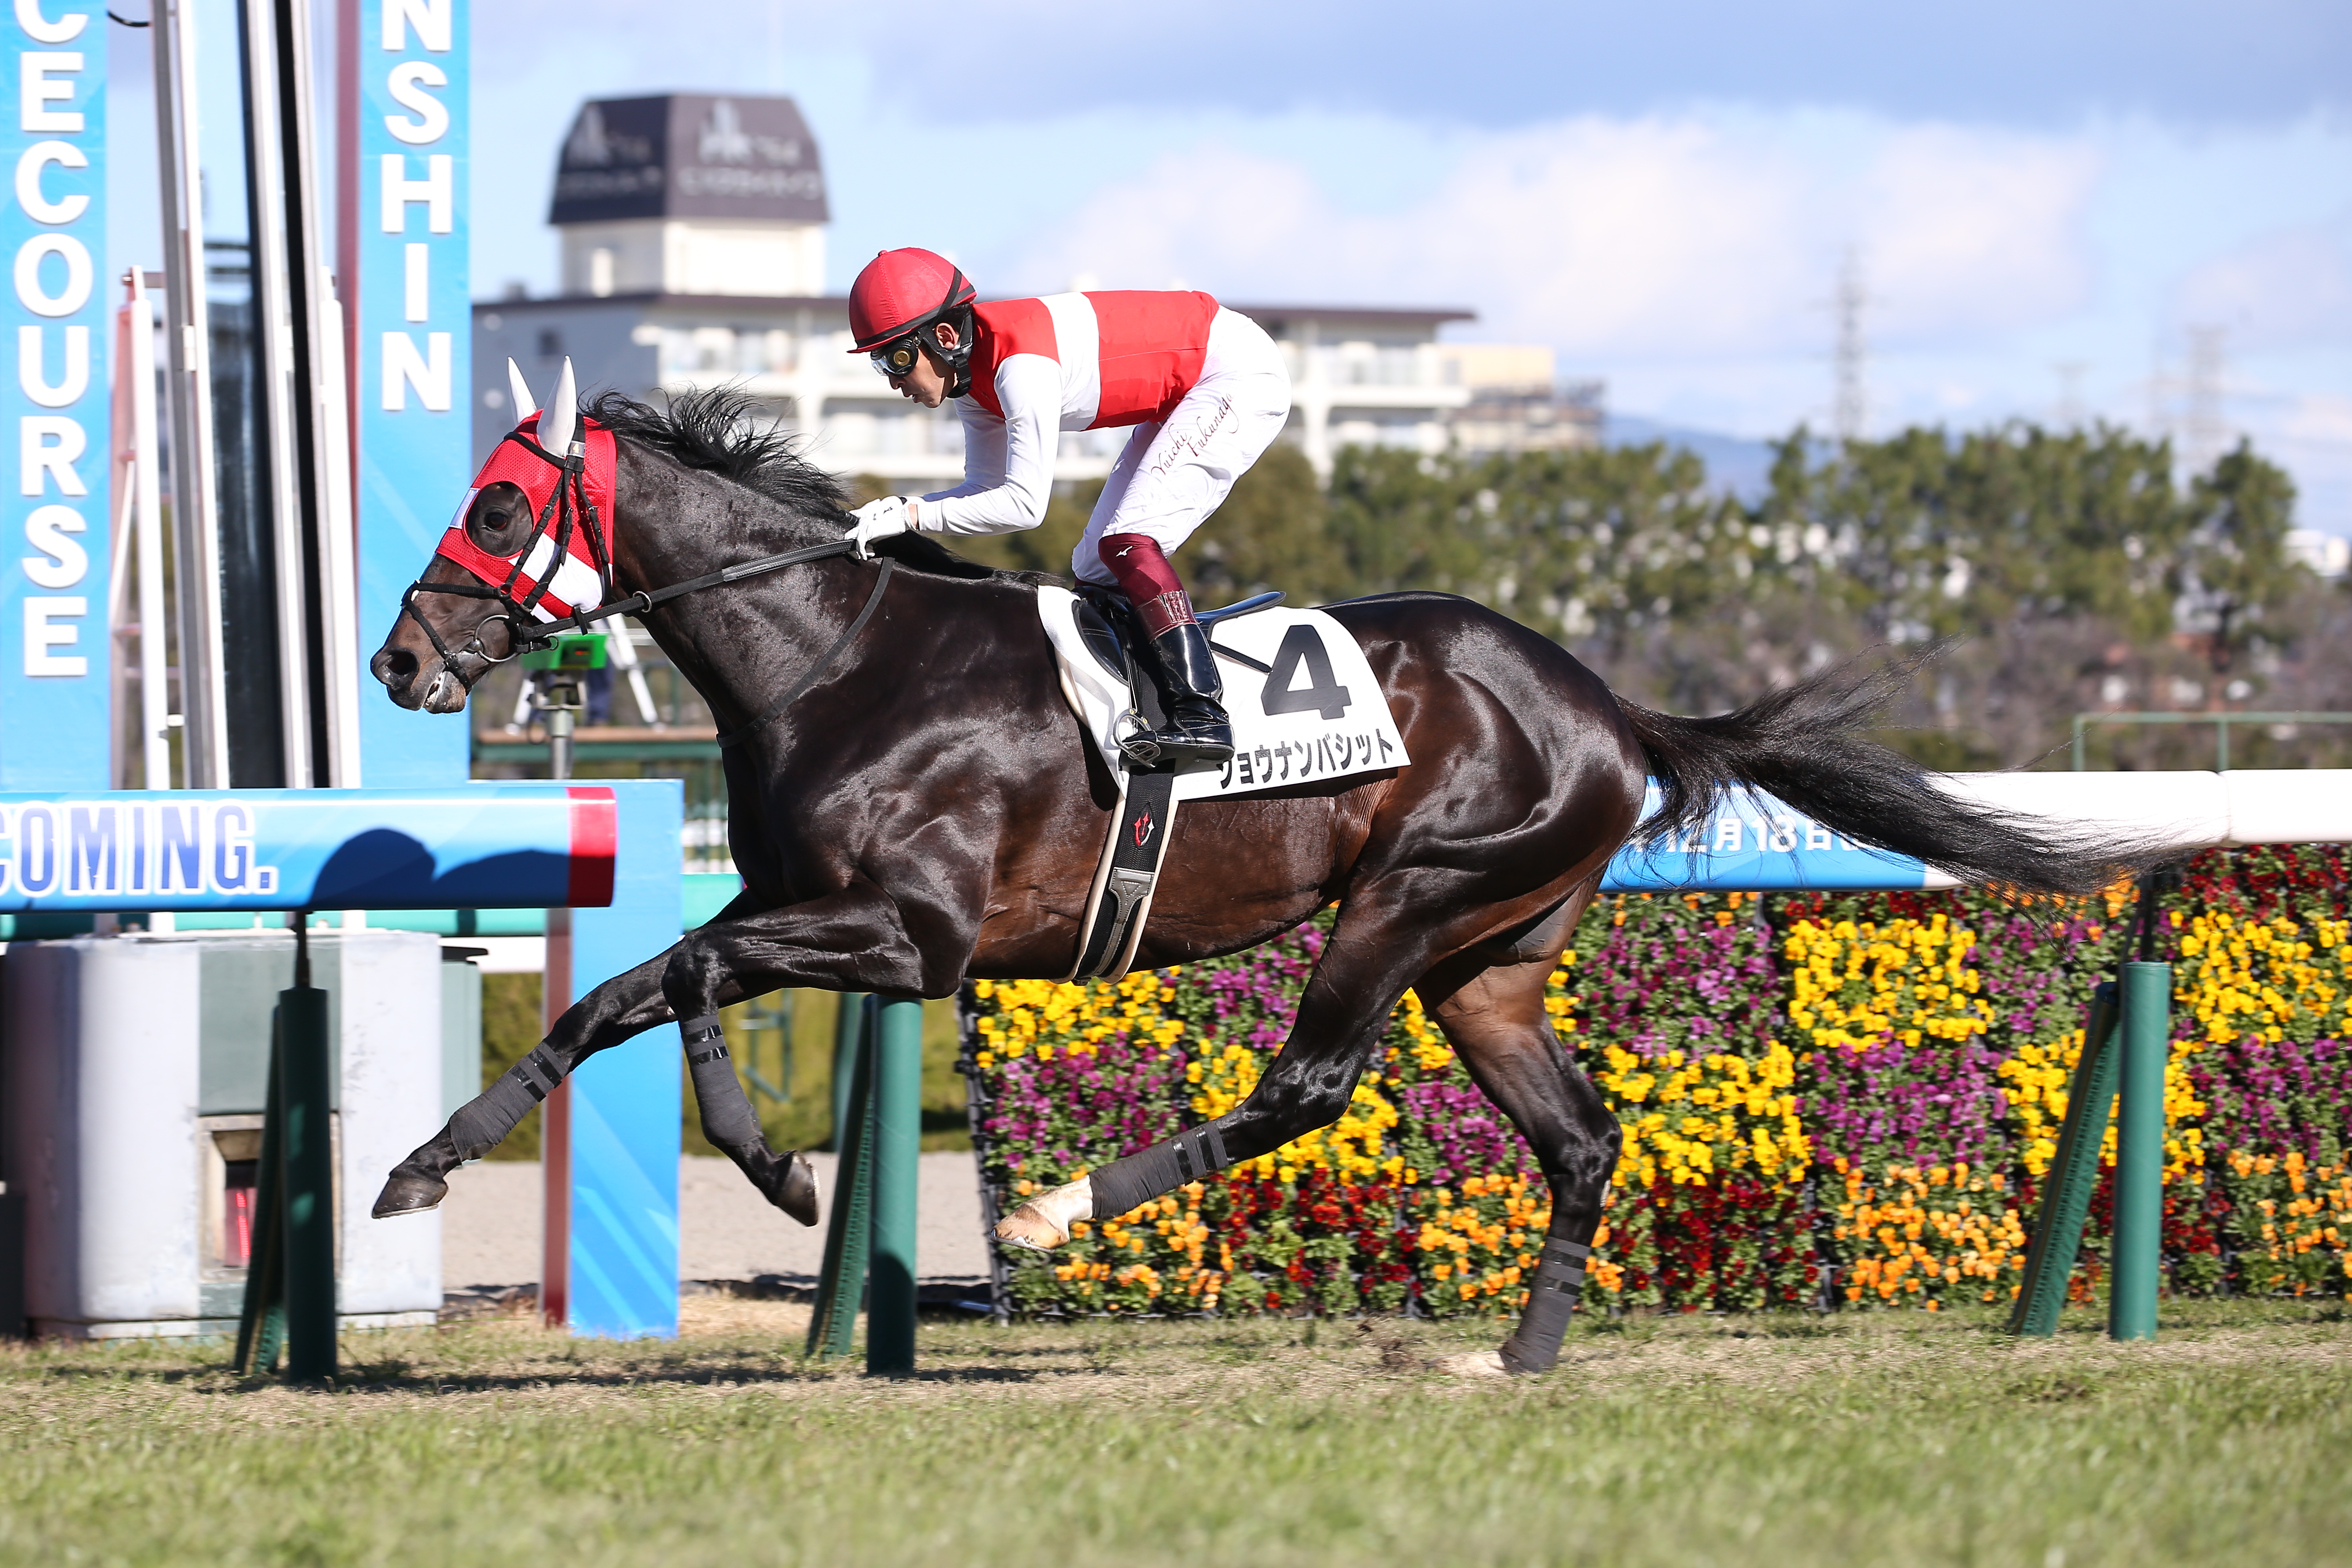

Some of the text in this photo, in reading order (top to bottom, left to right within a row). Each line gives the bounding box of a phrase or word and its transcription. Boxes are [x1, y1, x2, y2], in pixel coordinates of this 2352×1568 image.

[1186, 393, 1239, 457] Fukunaga
[1261, 624, 1352, 720] 4
[0, 802, 275, 894] OMING.
